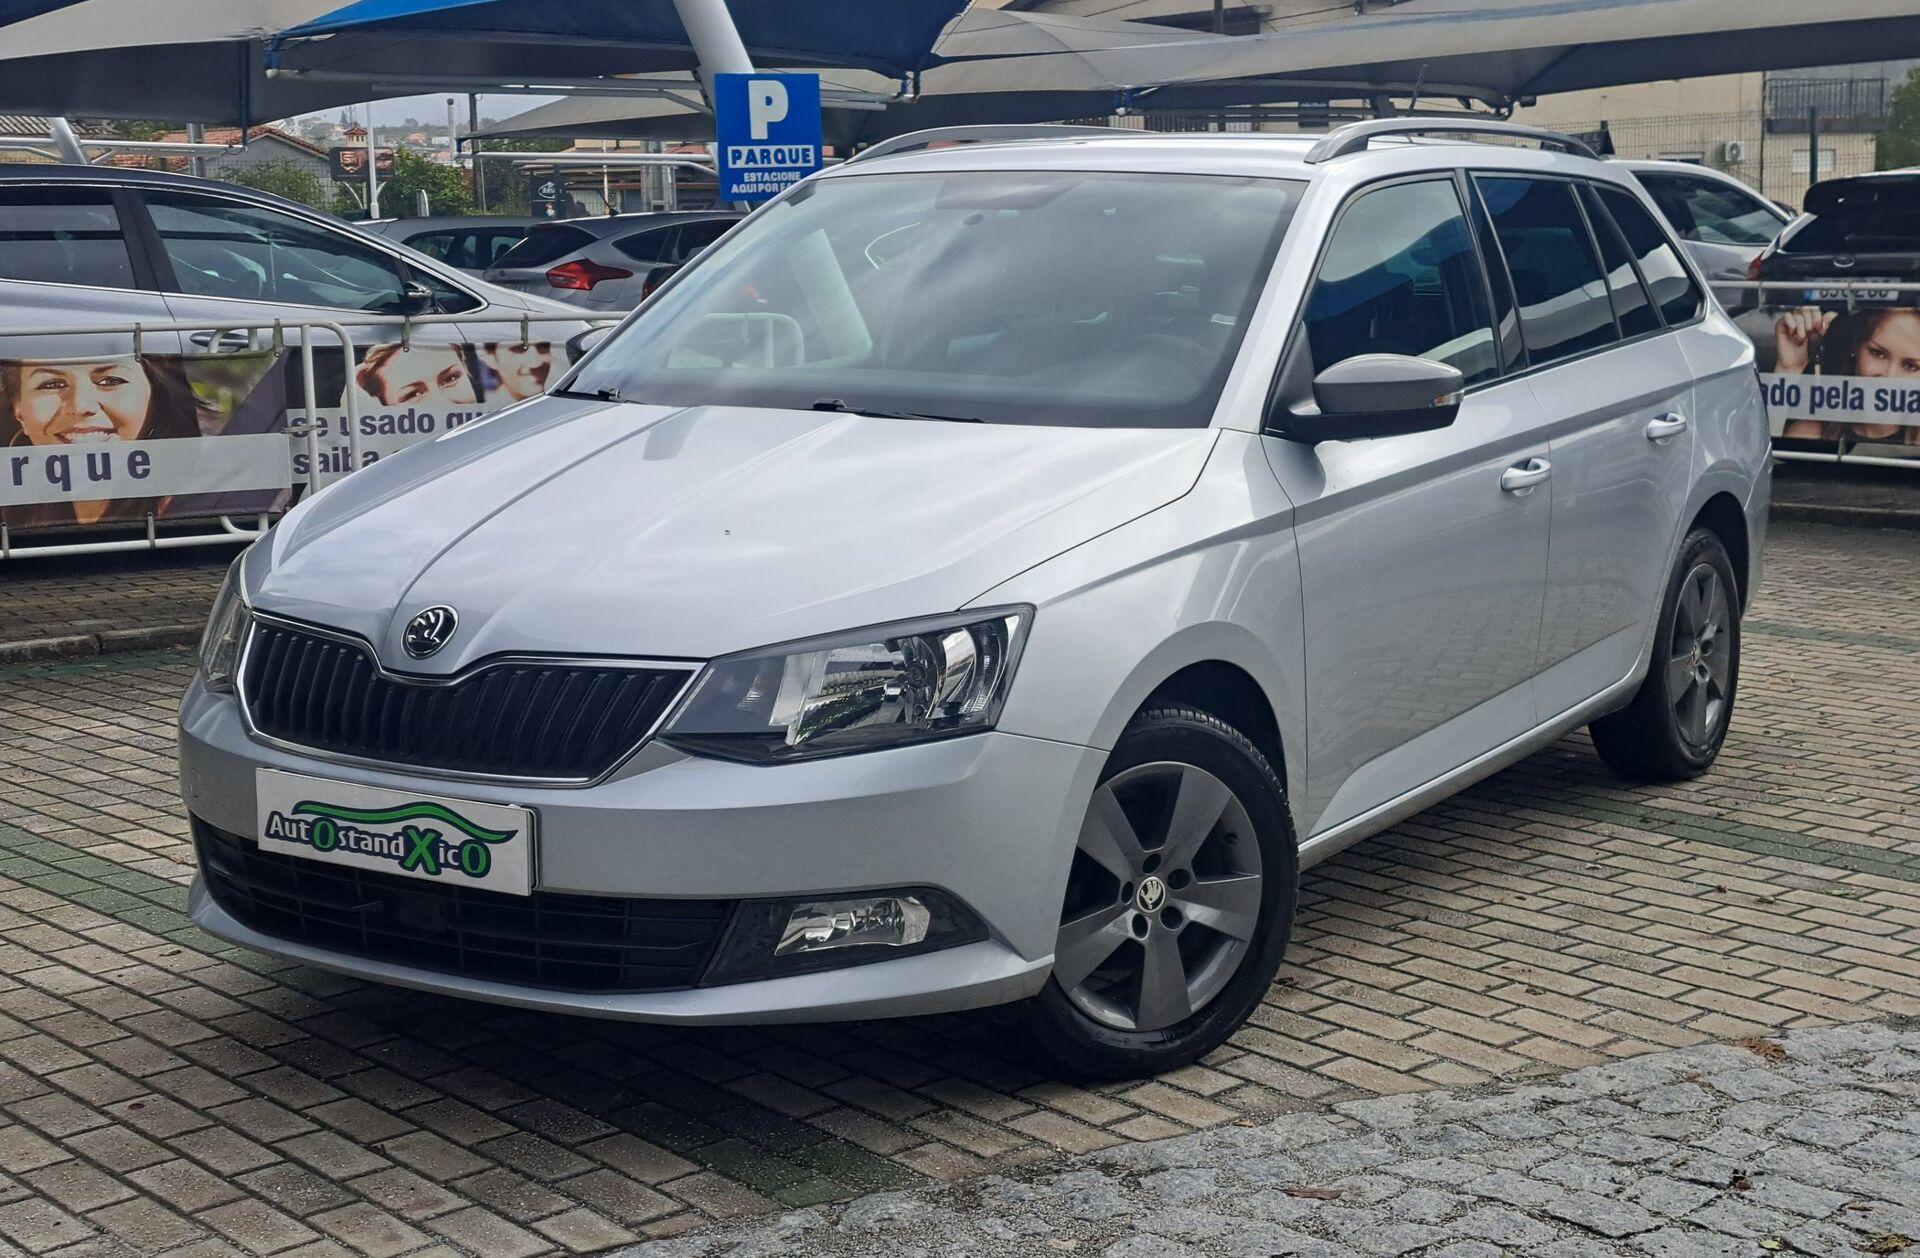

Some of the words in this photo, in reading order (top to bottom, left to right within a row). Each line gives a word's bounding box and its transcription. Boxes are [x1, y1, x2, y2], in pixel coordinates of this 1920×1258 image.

[748, 80, 788, 139] P
[731, 147, 811, 165] PARQUE
[744, 171, 801, 182] ESTACIONE
[1809, 380, 1864, 415] pela
[1873, 388, 1920, 413] sua
[11, 450, 150, 492] rque
